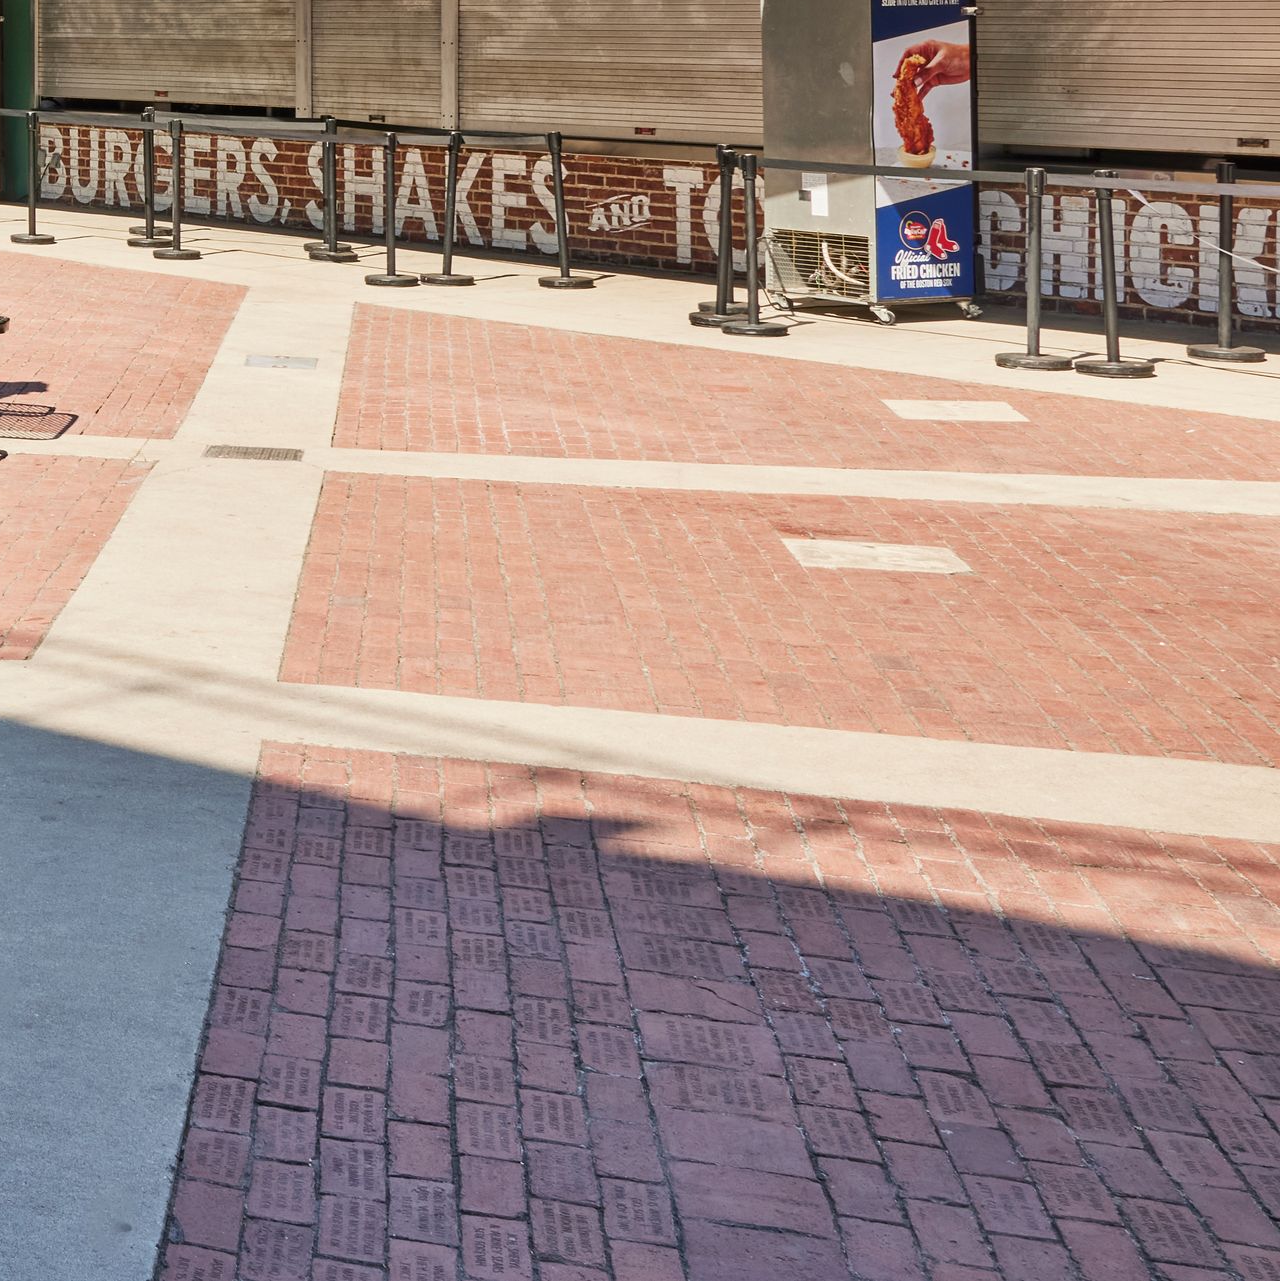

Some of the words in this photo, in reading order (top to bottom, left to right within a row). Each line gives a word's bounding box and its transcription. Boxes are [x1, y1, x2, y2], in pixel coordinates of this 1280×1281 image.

[40, 124, 292, 226] BURGERS,
[305, 140, 569, 255] SHAKES
[588, 195, 650, 233] AND
[895, 250, 931, 266] Official
[978, 190, 1280, 318] CHICK
[891, 264, 918, 280] FRIED
[920, 263, 961, 278] CHICKEN
[900, 281, 906, 289] OF
[916, 280, 933, 288] BOSTON
[934, 279, 942, 287] RED
[943, 279, 952, 287] SOX
